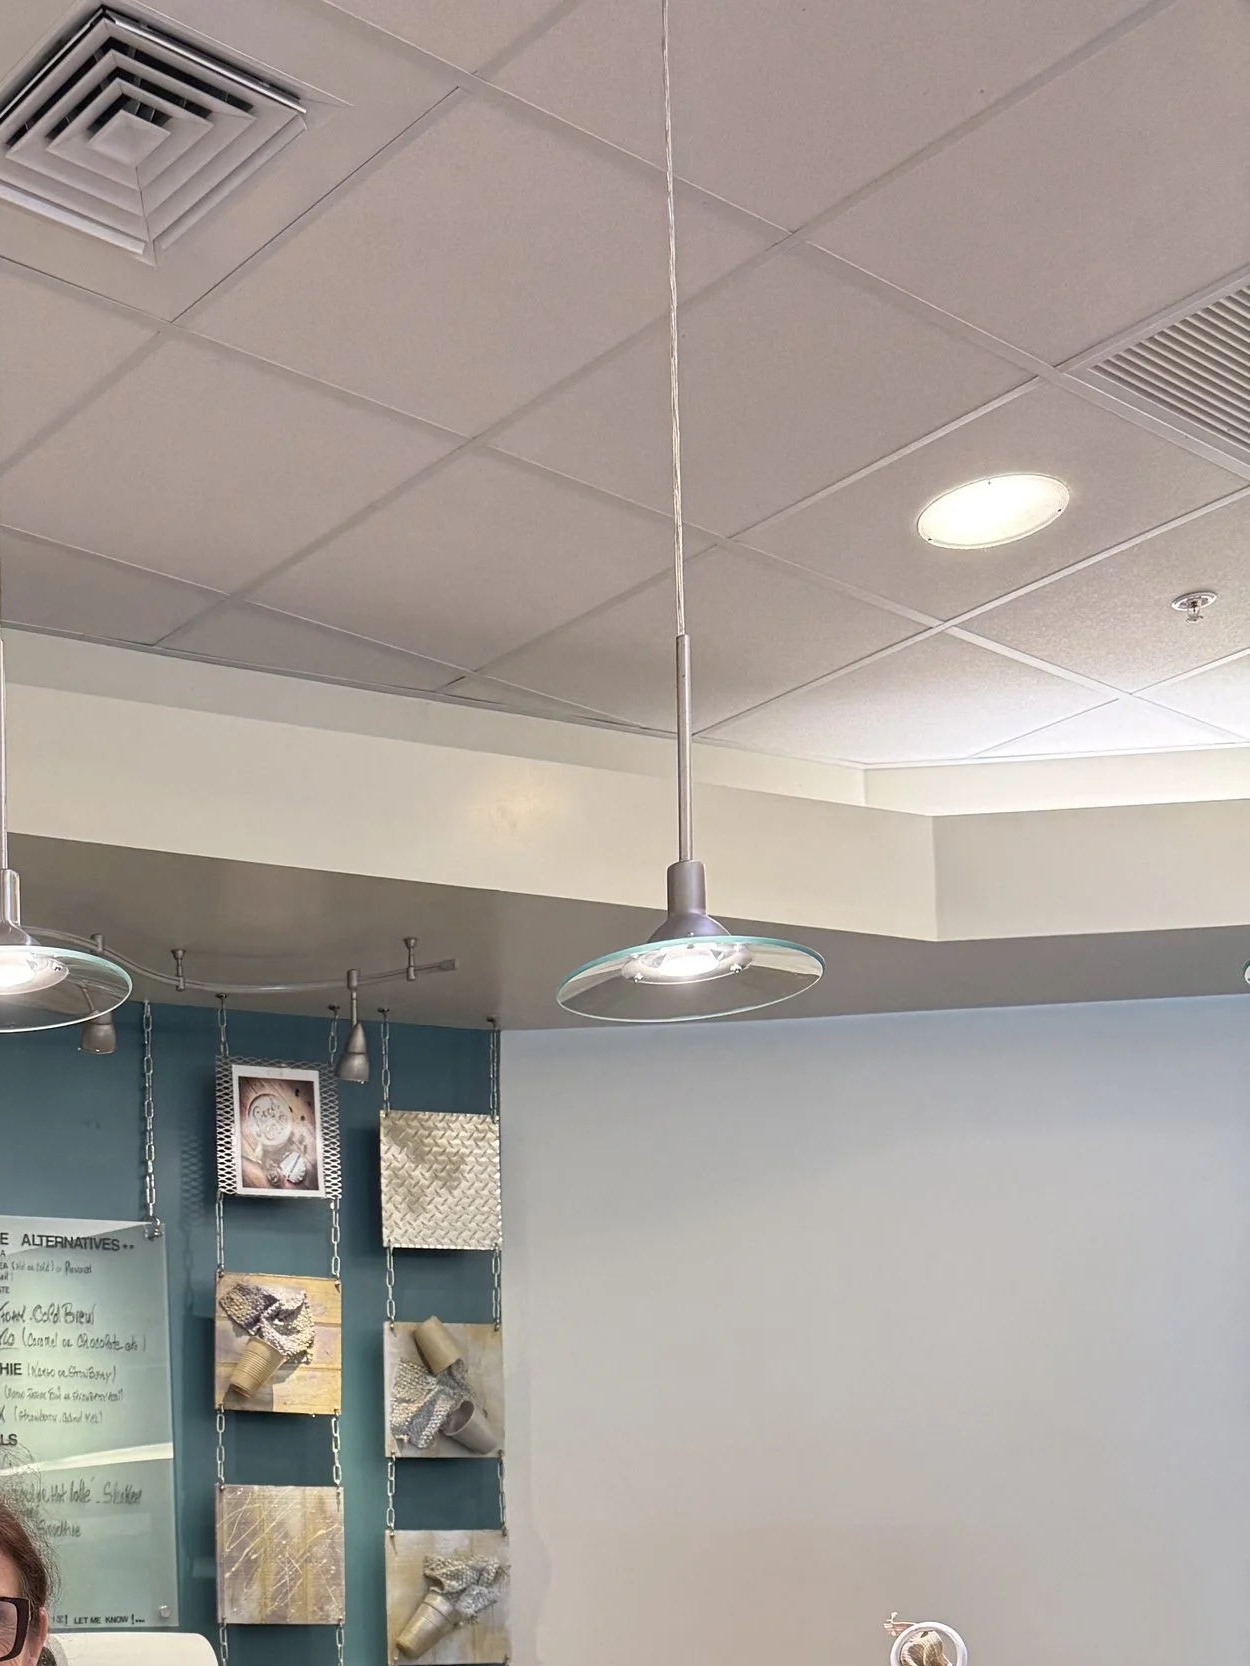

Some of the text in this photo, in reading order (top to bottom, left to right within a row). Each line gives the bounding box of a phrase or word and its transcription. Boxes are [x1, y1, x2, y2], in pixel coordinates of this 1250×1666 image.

[73, 1616, 88, 1625] LET
[90, 1616, 102, 1624] ME
[105, 1615, 129, 1624] KNOW
